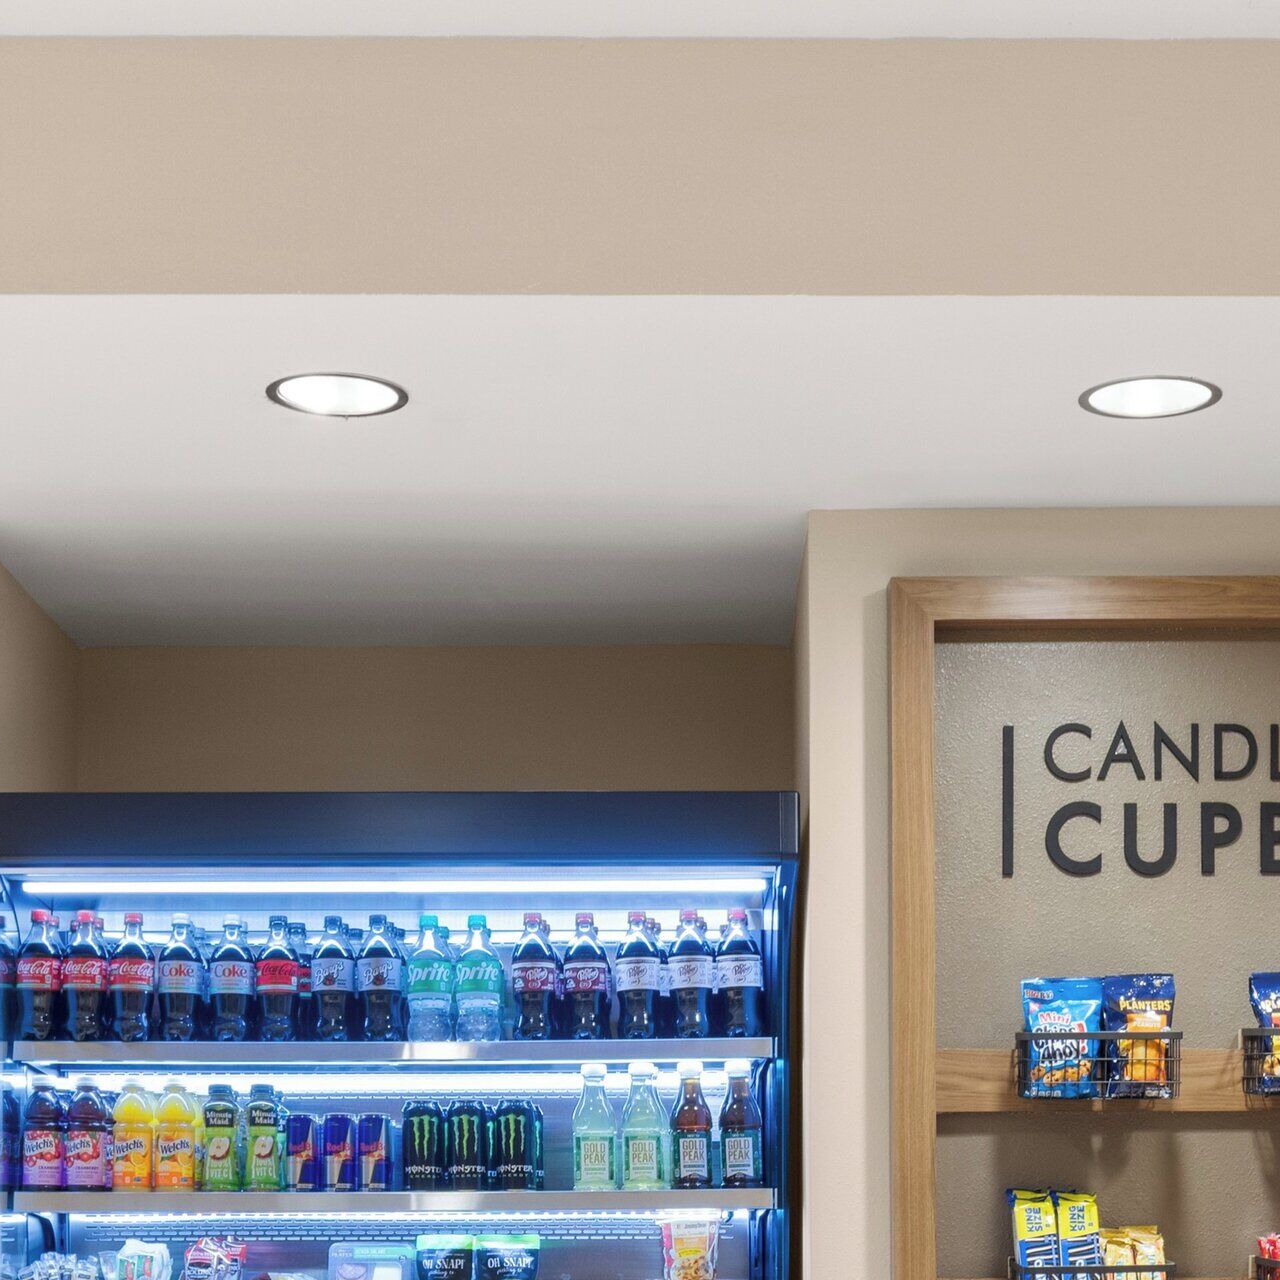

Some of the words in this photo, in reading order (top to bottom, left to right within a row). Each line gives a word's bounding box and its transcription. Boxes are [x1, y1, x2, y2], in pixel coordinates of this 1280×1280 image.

[162, 963, 194, 977] Coke
[214, 963, 248, 977] Coke
[407, 962, 451, 986] Sprite
[455, 961, 499, 986] Sprite
[1120, 1000, 1172, 1012] PLANTERS
[206, 1110, 232, 1119] Minute
[252, 1109, 277, 1119] Minute
[209, 1117, 228, 1125] Maid
[255, 1116, 274, 1124] Maid
[25, 1138, 54, 1154] Welch's
[115, 1138, 144, 1155] Welch's
[161, 1138, 190, 1155] Welch's
[584, 1142, 605, 1152] GOLD
[631, 1142, 653, 1152] GOLD
[682, 1139, 704, 1149] GOLD
[728, 1139, 749, 1149] GOLD
[584, 1152, 605, 1163] PEAK
[632, 1152, 654, 1163] PEAK
[683, 1150, 705, 1161] PEAK
[728, 1150, 749, 1161] PEAK
[1025, 1207, 1034, 1232] KING
[1033, 1207, 1043, 1232] SIZE
[1069, 1205, 1077, 1232] KING
[1077, 1205, 1086, 1231] SIZE
[422, 1259, 433, 1269] OH
[436, 1259, 465, 1269] SNAP!
[488, 1258, 500, 1268] OH
[503, 1257, 531, 1268] SNAP!
